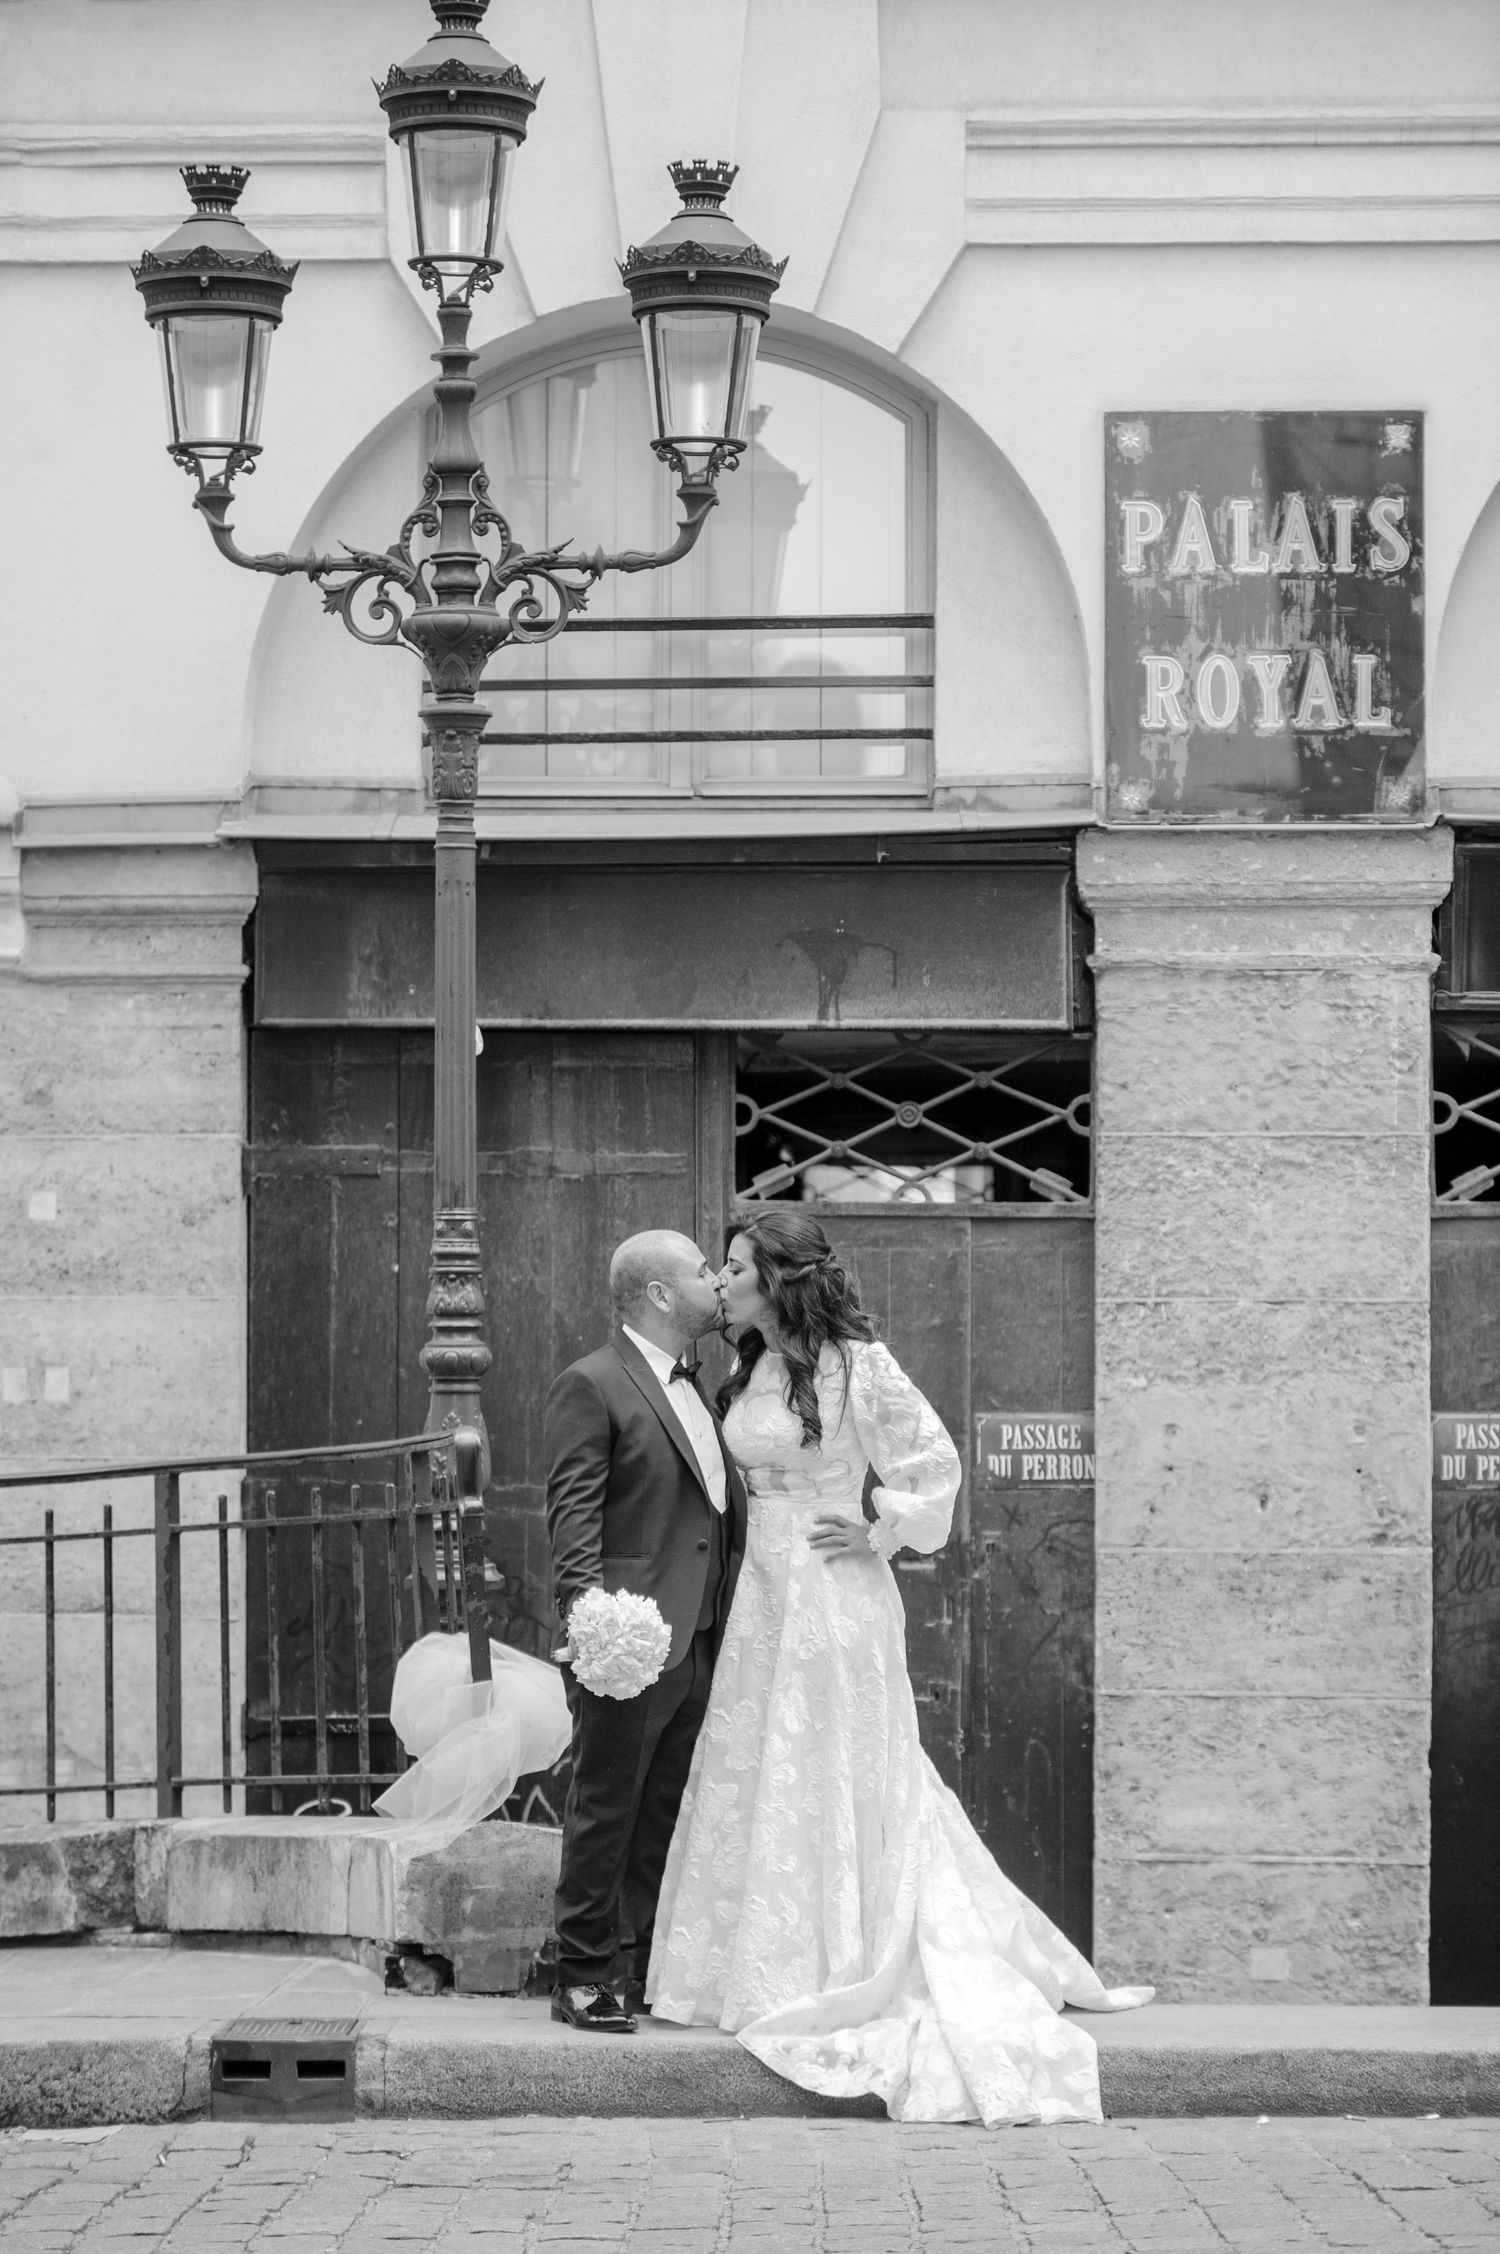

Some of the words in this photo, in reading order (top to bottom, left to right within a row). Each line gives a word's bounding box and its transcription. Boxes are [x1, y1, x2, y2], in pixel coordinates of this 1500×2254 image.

[1119, 498, 1410, 574] PALAIS
[1140, 648, 1393, 730] ROYAL
[1001, 1423, 1082, 1450] PASSAGE
[1021, 1454, 1096, 1481] PERRON
[1441, 1454, 1467, 1481] DU
